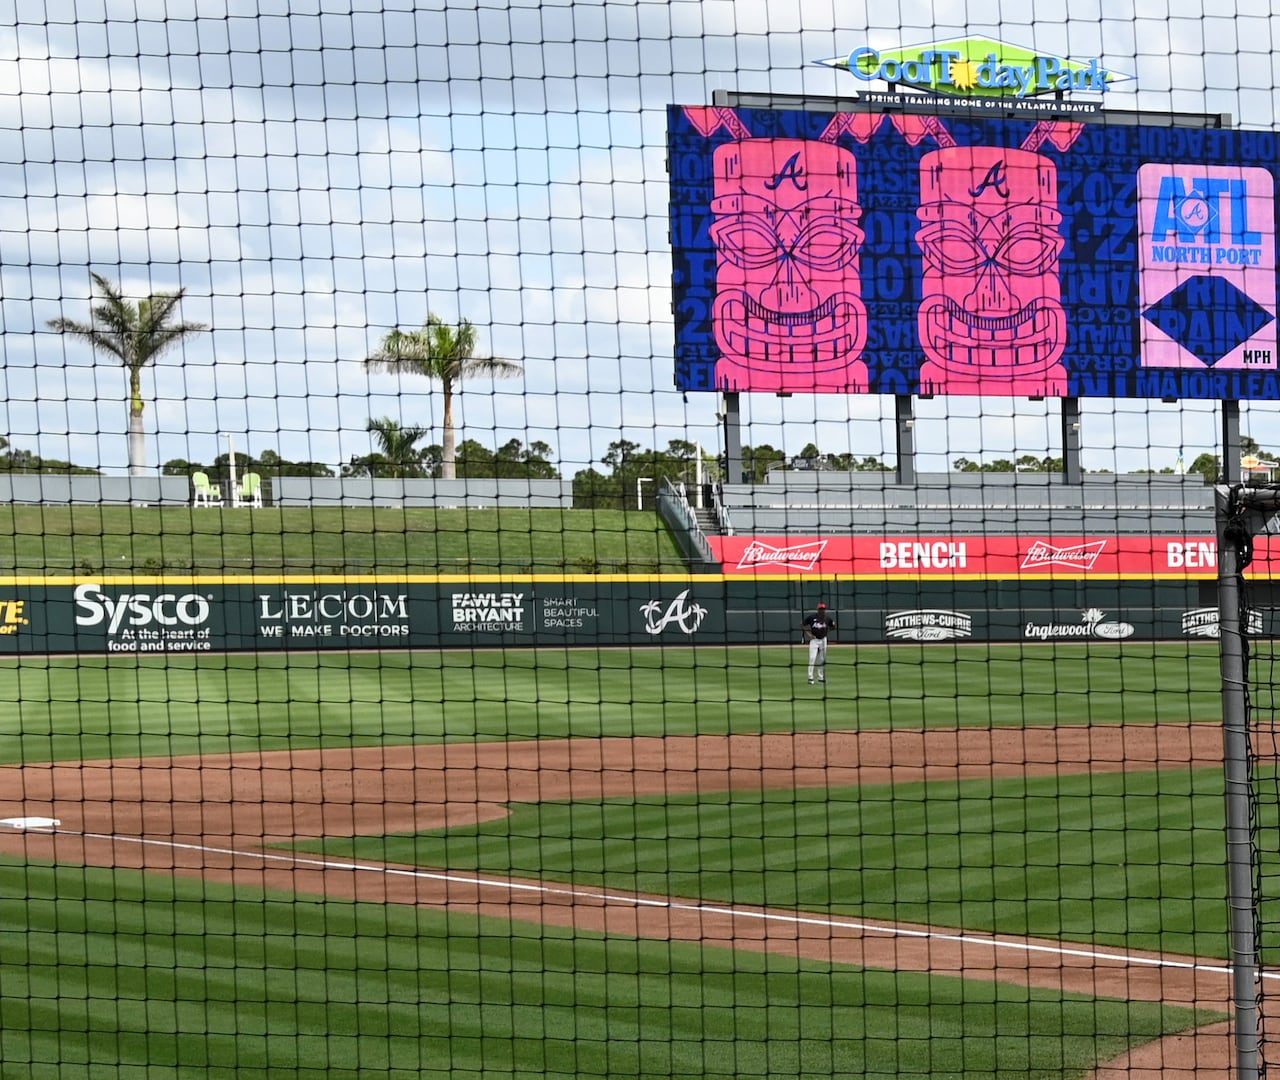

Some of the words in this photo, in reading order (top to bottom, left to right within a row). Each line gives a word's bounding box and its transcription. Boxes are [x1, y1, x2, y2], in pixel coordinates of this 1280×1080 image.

[1036, 58, 1111, 91] Park
[865, 95, 900, 104] SPRING
[904, 97, 950, 107] TRAINING
[953, 99, 982, 108] HOME
[985, 101, 996, 109] OF
[997, 101, 1013, 110] THE
[1016, 102, 1057, 112] ATLANTA
[1060, 103, 1096, 113] BRAVES
[1151, 176, 1263, 246] ATL
[1152, 246, 1211, 264] NORTH
[1215, 248, 1262, 266] PORT
[1242, 349, 1272, 364] MPH
[743, 543, 820, 564] Budweiser
[879, 541, 967, 569] BENCH
[1027, 545, 1099, 563] Budweiser
[1167, 541, 1218, 568] BEN
[74, 583, 210, 635] Sysco
[259, 593, 410, 619] LECOM
[452, 593, 524, 608] FAWLEY
[543, 597, 578, 607] SMART
[453, 608, 525, 622] BRYANT
[543, 608, 600, 618] BEAUTIFUL
[261, 625, 284, 637] WE
[291, 625, 333, 637] MAKE
[340, 625, 410, 637] DOCTORS
[453, 622, 524, 632] ARCHITECTURE
[543, 618, 583, 628] SPACES
[885, 614, 972, 632] MATTHEWS-CURRIE
[1024, 621, 1091, 640] Englewood
[122, 628, 136, 639] At
[139, 628, 159, 639] the
[162, 627, 195, 639] heart
[197, 627, 210, 639] of
[108, 639, 137, 651] food
[140, 640, 165, 651] and
[167, 640, 211, 651] service
